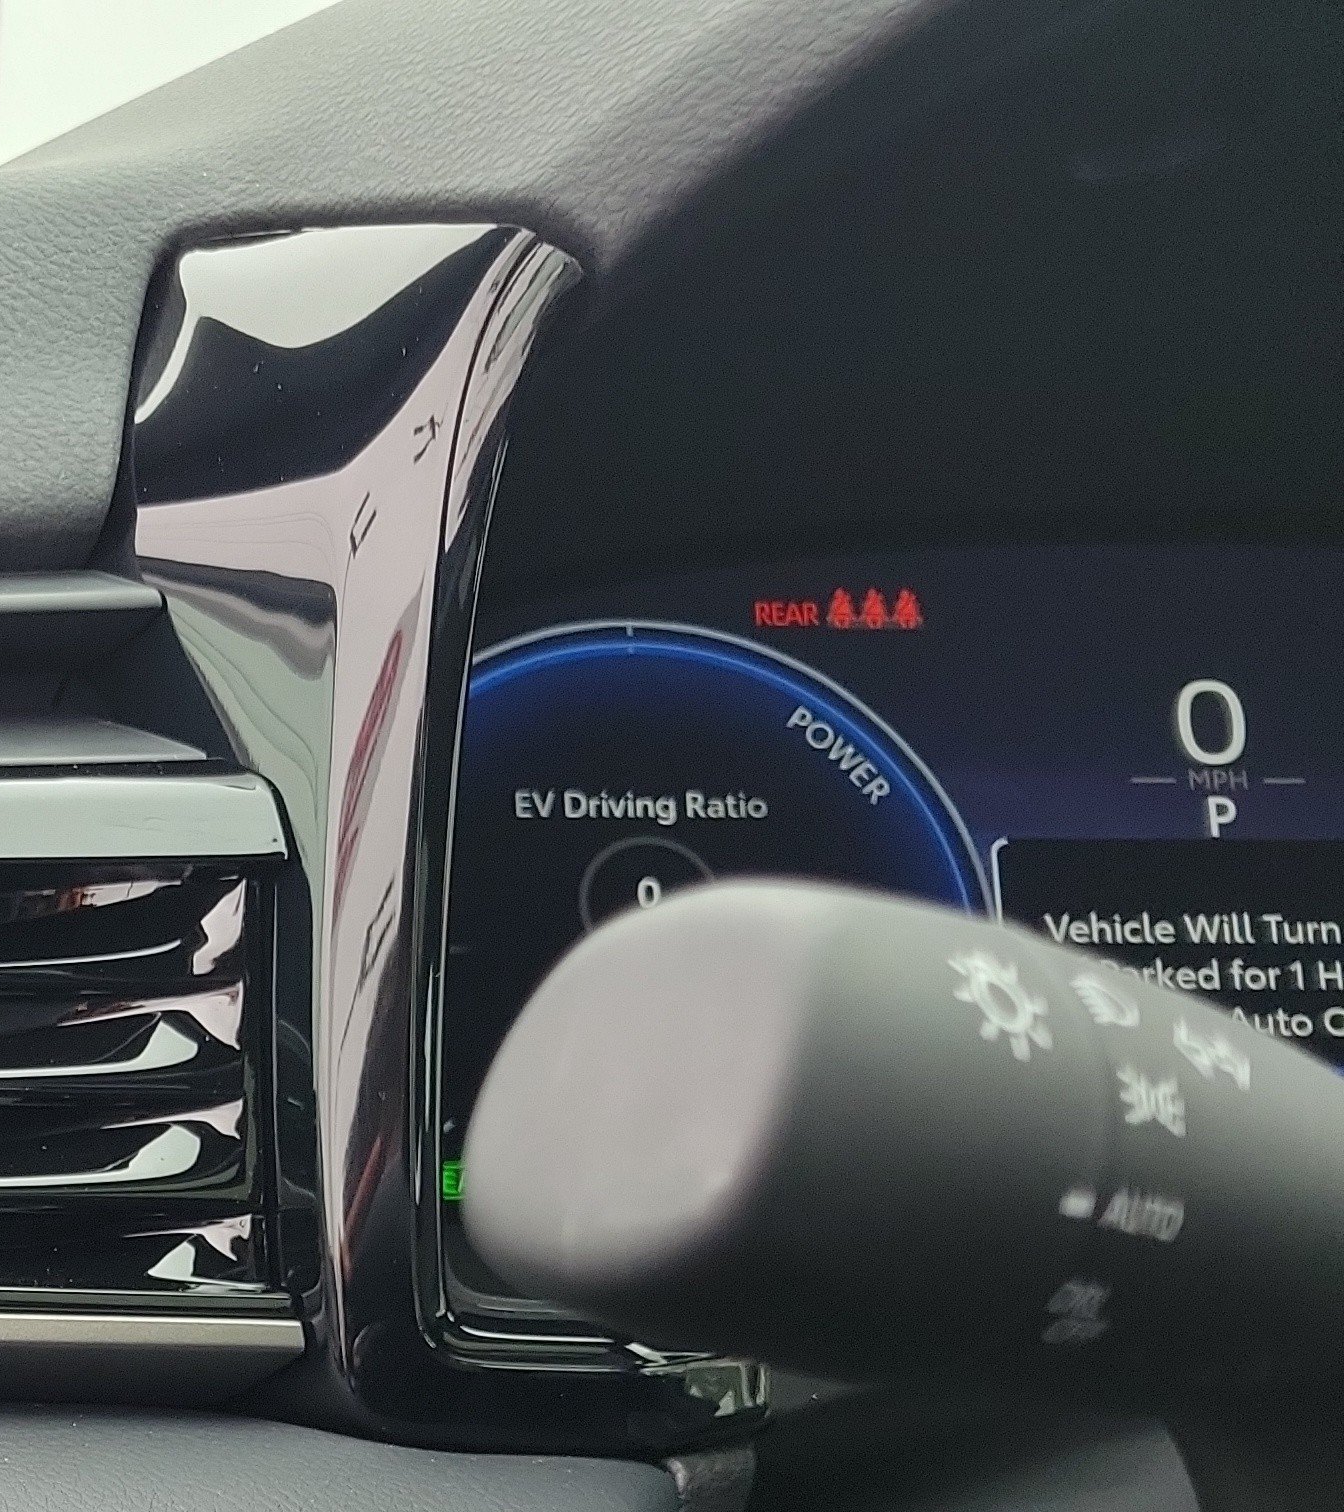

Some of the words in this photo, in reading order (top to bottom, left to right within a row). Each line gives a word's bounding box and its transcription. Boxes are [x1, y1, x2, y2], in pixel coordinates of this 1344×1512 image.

[754, 601, 819, 626] REAR
[1177, 677, 1246, 766] 0
[786, 704, 891, 806] POWER
[1186, 768, 1250, 792] MPH
[515, 789, 555, 819] EV
[563, 788, 678, 826] Driving
[685, 789, 769, 820] Ratio
[1207, 795, 1238, 838] P
[636, 875, 663, 910] 0
[1043, 911, 1176, 944] Vehicle
[1183, 911, 1256, 944] Will
[1261, 912, 1344, 944] Turn
[1230, 957, 1282, 991] for
[1288, 960, 1305, 991] 1
[1096, 1186, 1185, 1243] AUTO
